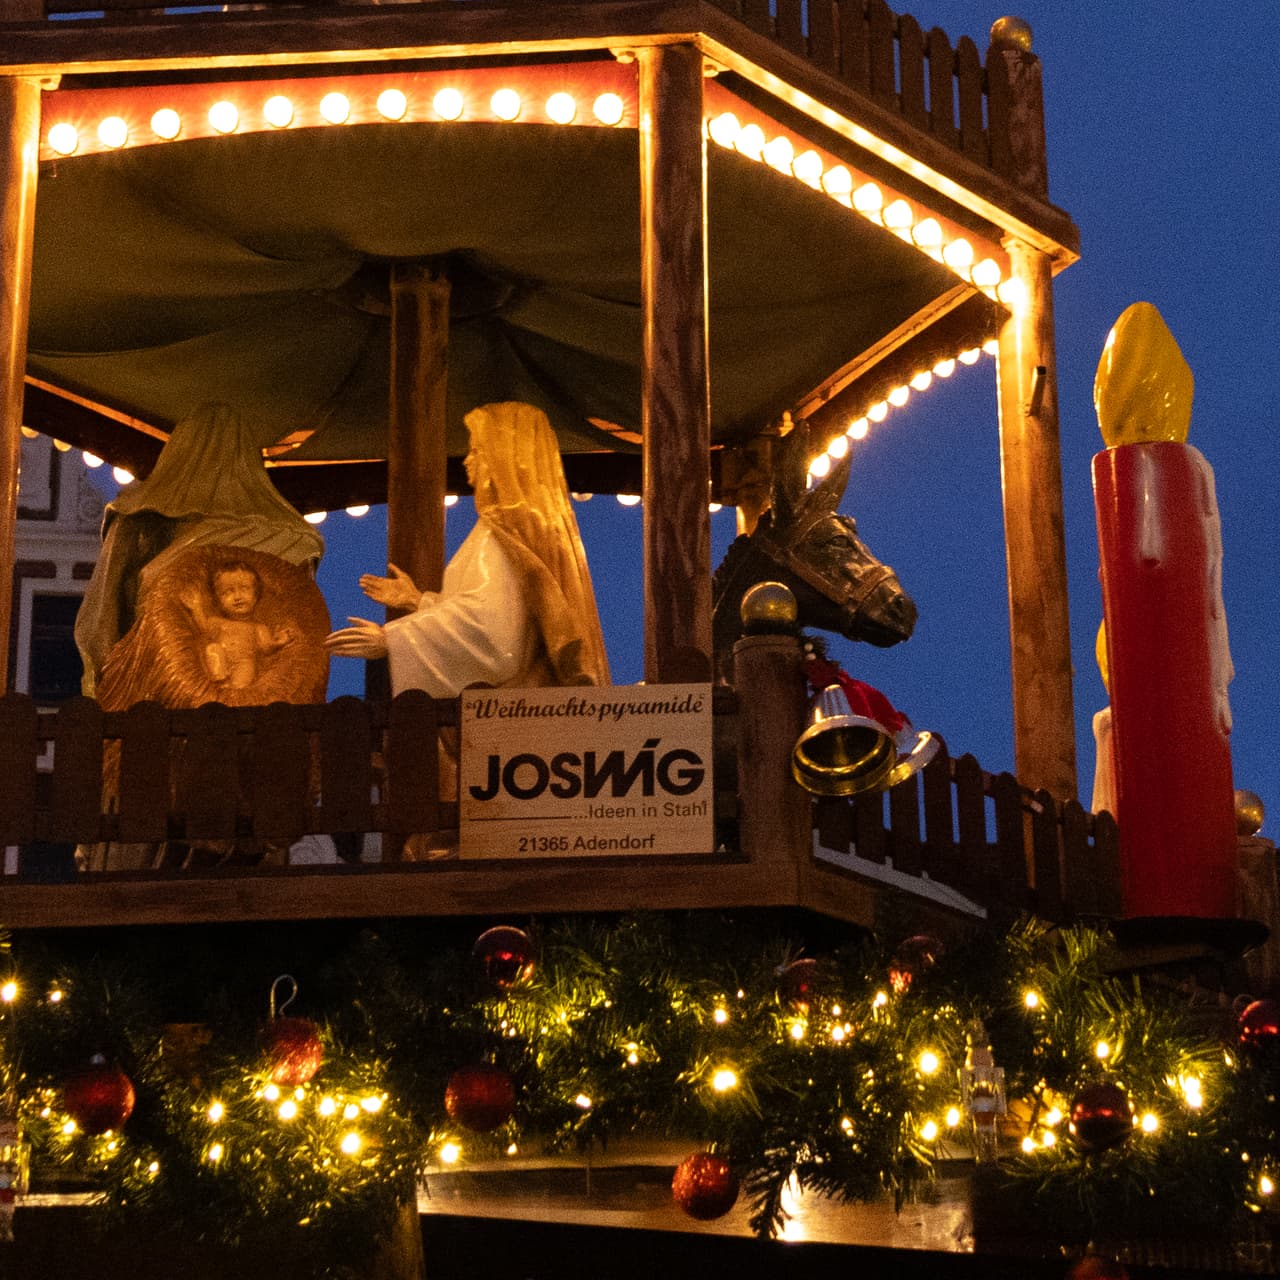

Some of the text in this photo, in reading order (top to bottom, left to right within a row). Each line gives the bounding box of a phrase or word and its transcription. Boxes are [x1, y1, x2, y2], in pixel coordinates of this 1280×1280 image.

[470, 738, 705, 801] JOSWIG
[642, 803, 657, 817] in
[663, 801, 707, 817] Stahl
[519, 834, 656, 851] 21365 Adendorf
